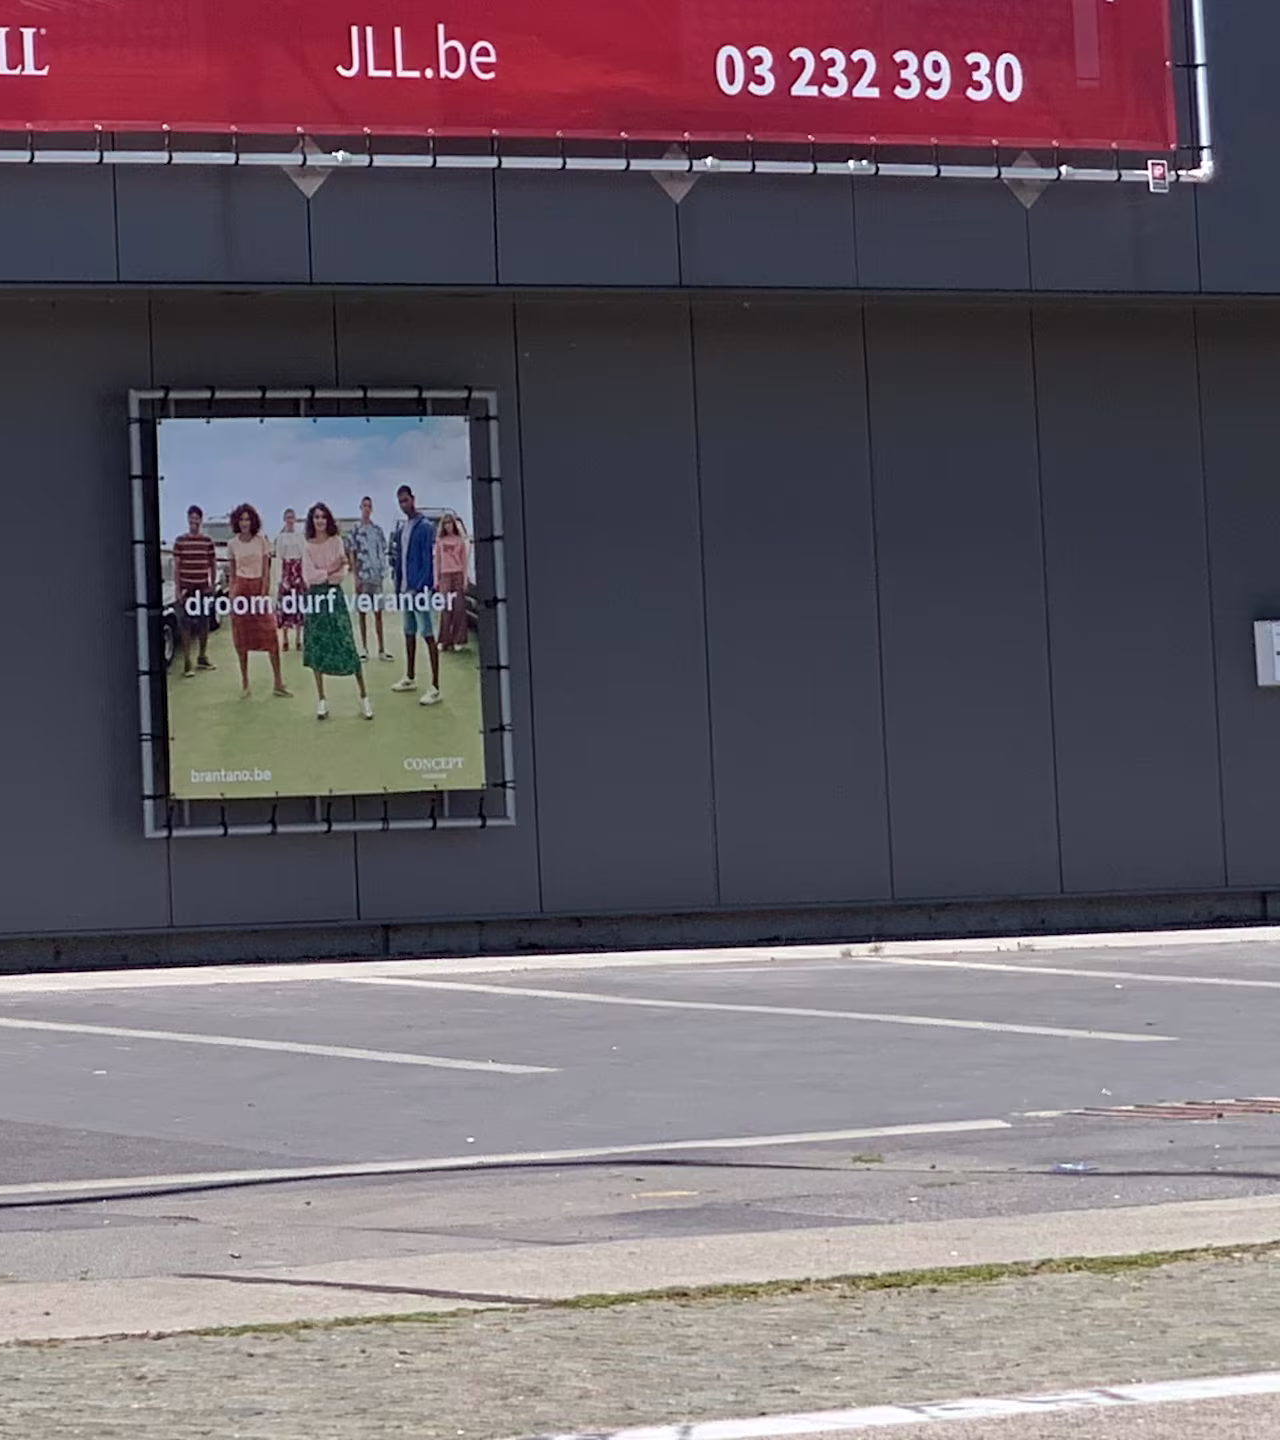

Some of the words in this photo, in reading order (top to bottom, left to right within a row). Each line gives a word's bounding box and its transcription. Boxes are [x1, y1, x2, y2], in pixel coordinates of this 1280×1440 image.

[335, 23, 498, 81] JLL.be
[715, 44, 776, 97] 03
[788, 46, 881, 98] 232
[892, 49, 952, 100] 39
[964, 51, 1024, 103] 30
[184, 590, 273, 616] droom
[281, 588, 337, 613] durf
[345, 586, 458, 612] verander
[190, 768, 272, 783] brantano.be
[403, 758, 464, 771] CONCEPT
